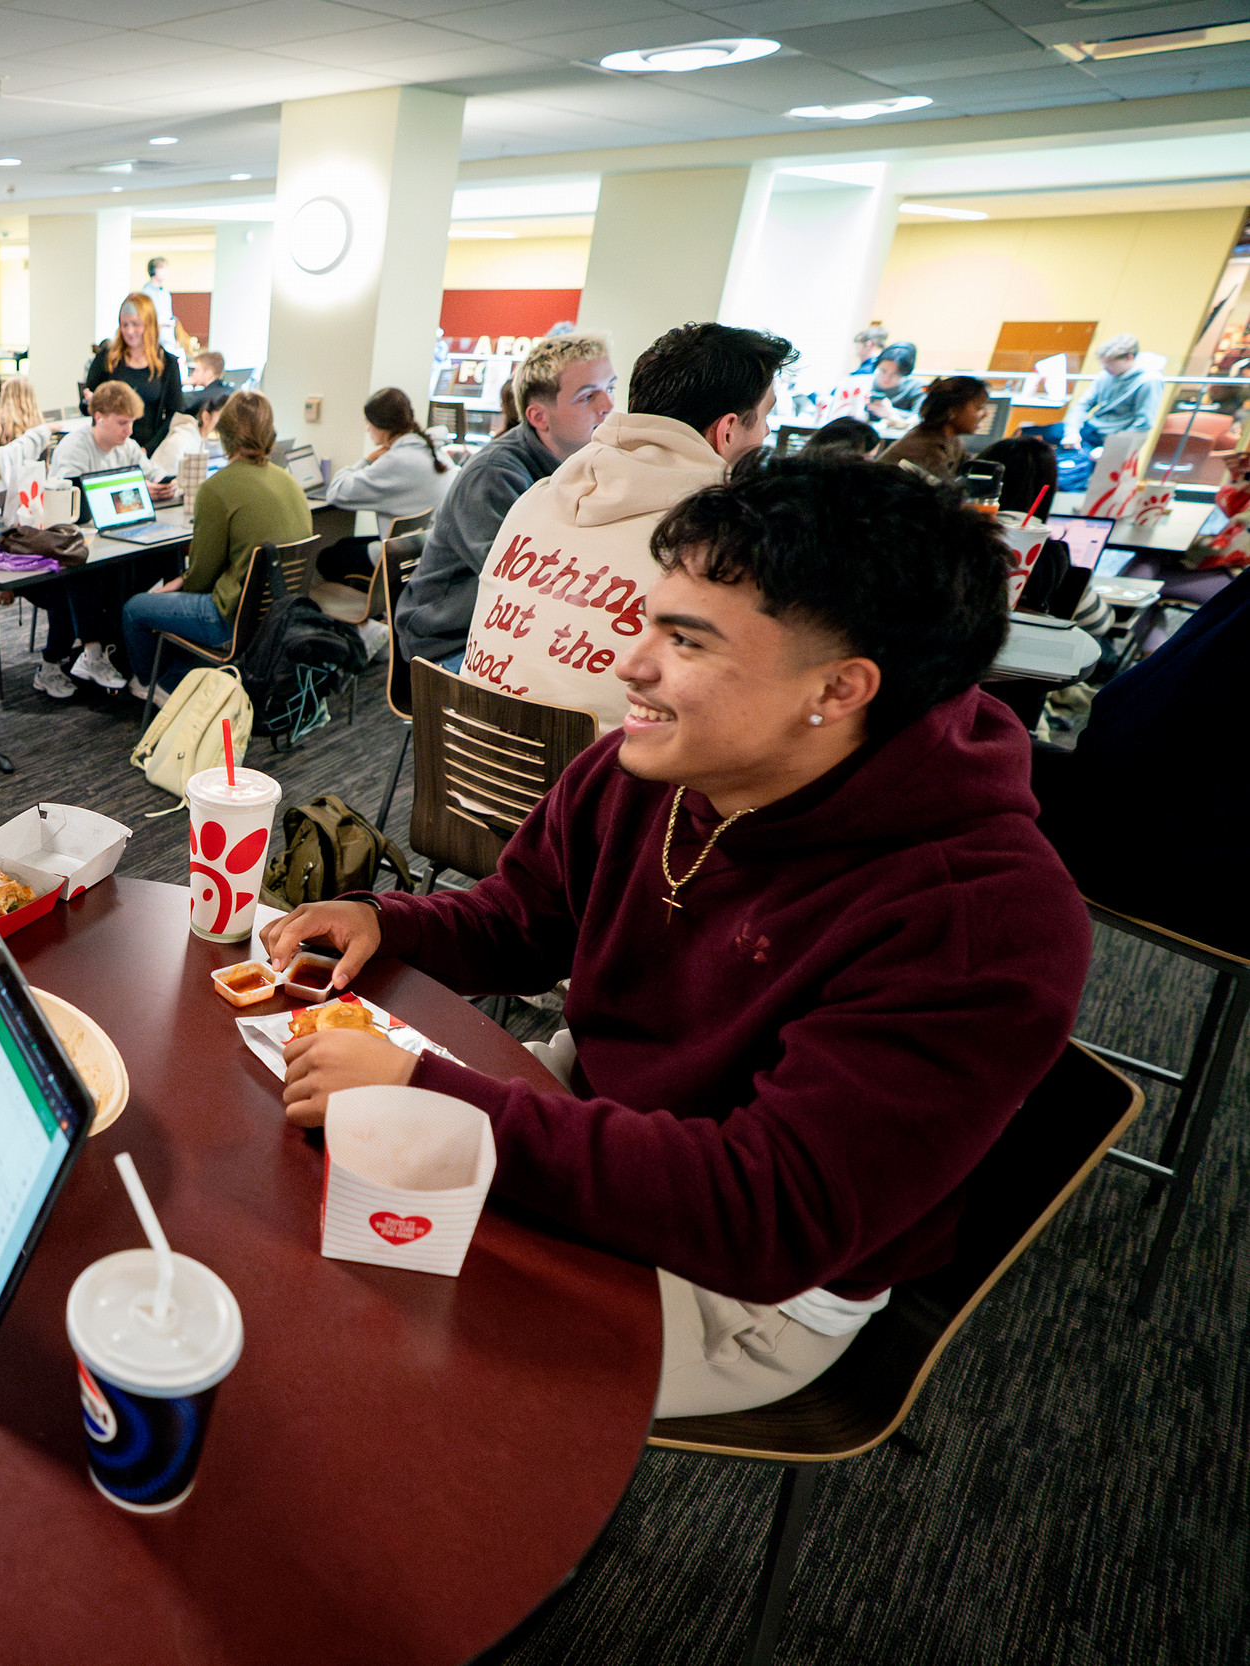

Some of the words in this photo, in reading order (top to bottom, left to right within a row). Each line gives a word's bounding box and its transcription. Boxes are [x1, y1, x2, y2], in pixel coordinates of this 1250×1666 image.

[473, 336, 492, 355] A
[493, 534, 647, 636] Nothing
[484, 594, 536, 639] but
[464, 632, 514, 684] blood
[548, 624, 616, 673] the
